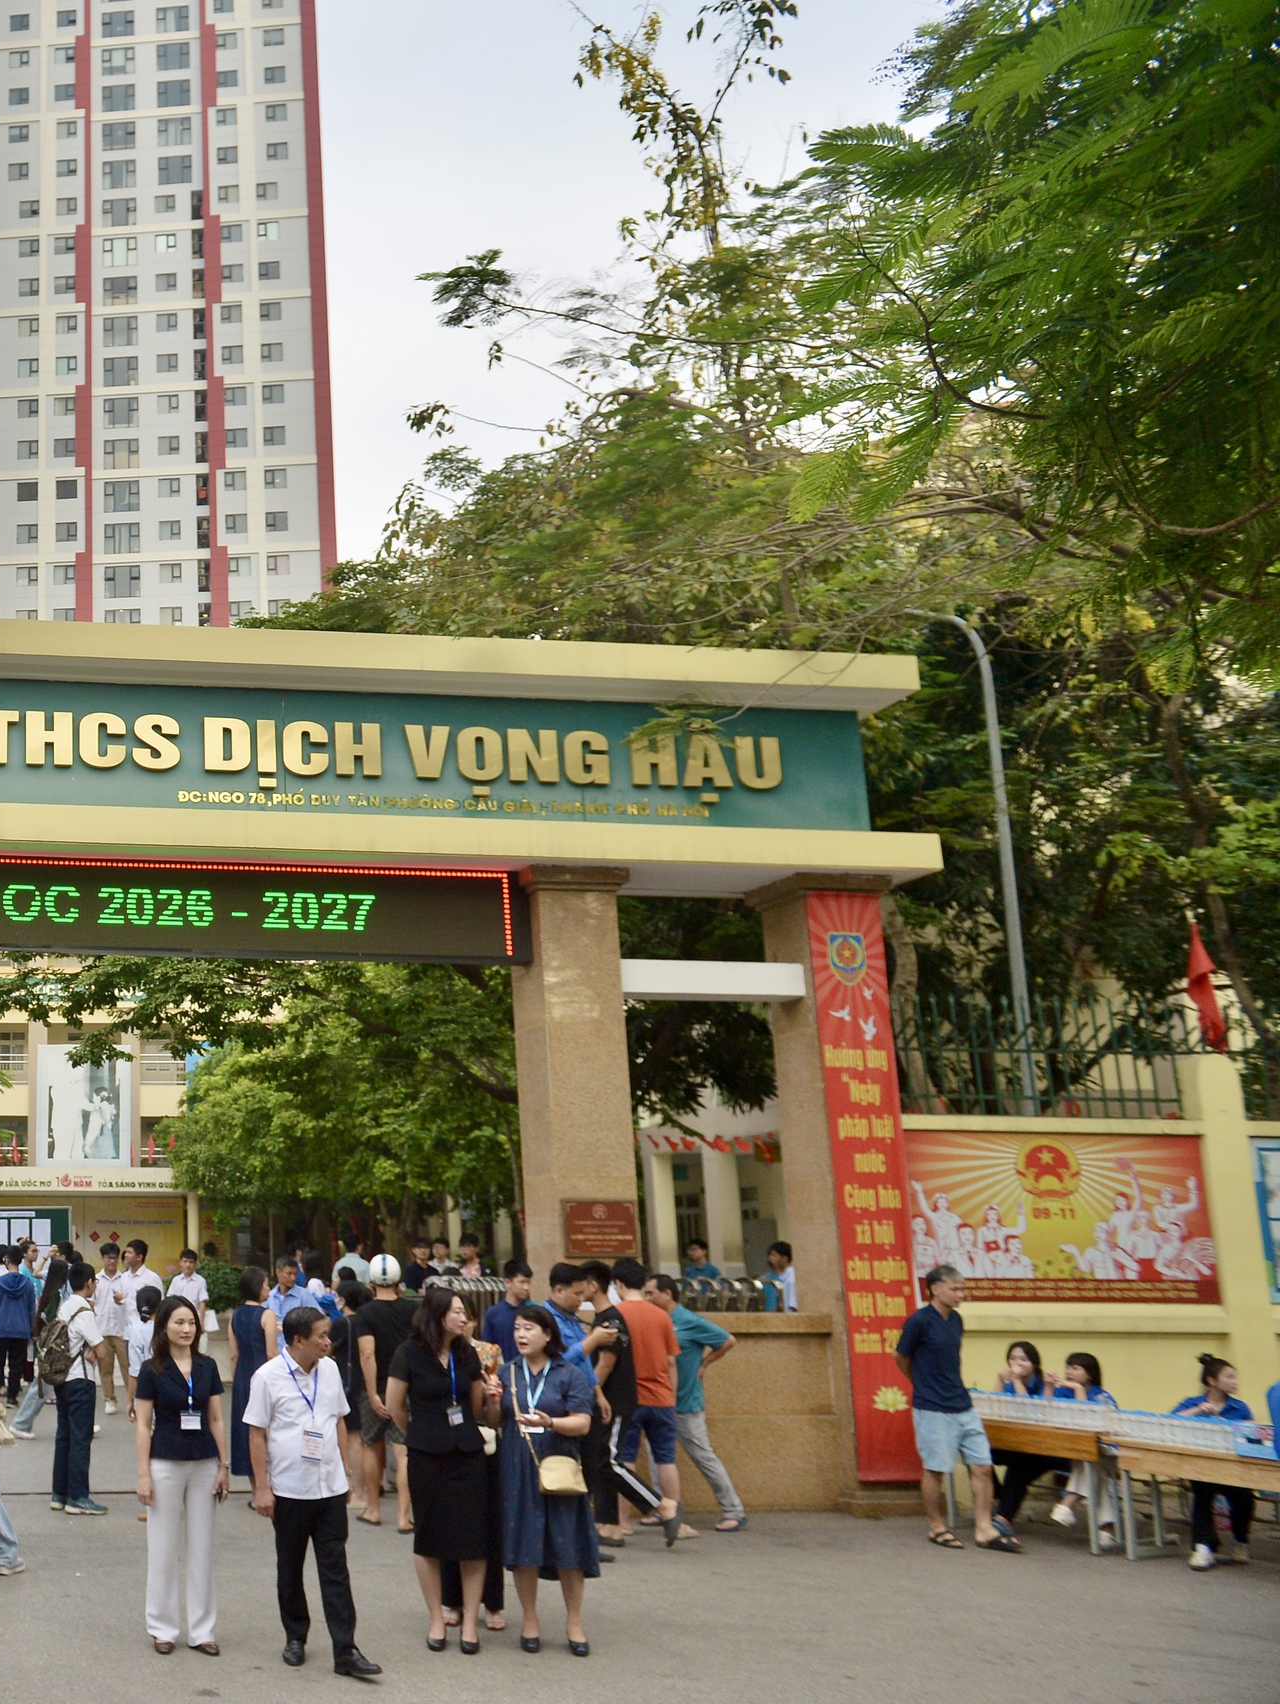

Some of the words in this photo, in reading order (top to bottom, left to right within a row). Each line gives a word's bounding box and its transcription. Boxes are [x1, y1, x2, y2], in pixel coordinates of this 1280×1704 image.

[203, 716, 382, 789] DỊCH
[404, 724, 611, 797] VỌNG
[310, 794, 340, 807] DUY
[656, 801, 678, 817] HÀ
[97, 887, 214, 927] 2026
[262, 891, 376, 931] 2027
[837, 1113, 869, 1140] pháp
[871, 1113, 895, 1144] luật
[854, 1149, 886, 1173] nước
[844, 1183, 876, 1213] Cộng
[855, 1220, 872, 1245] xã
[872, 1220, 895, 1250] hội
[849, 1291, 875, 1322] Việt
